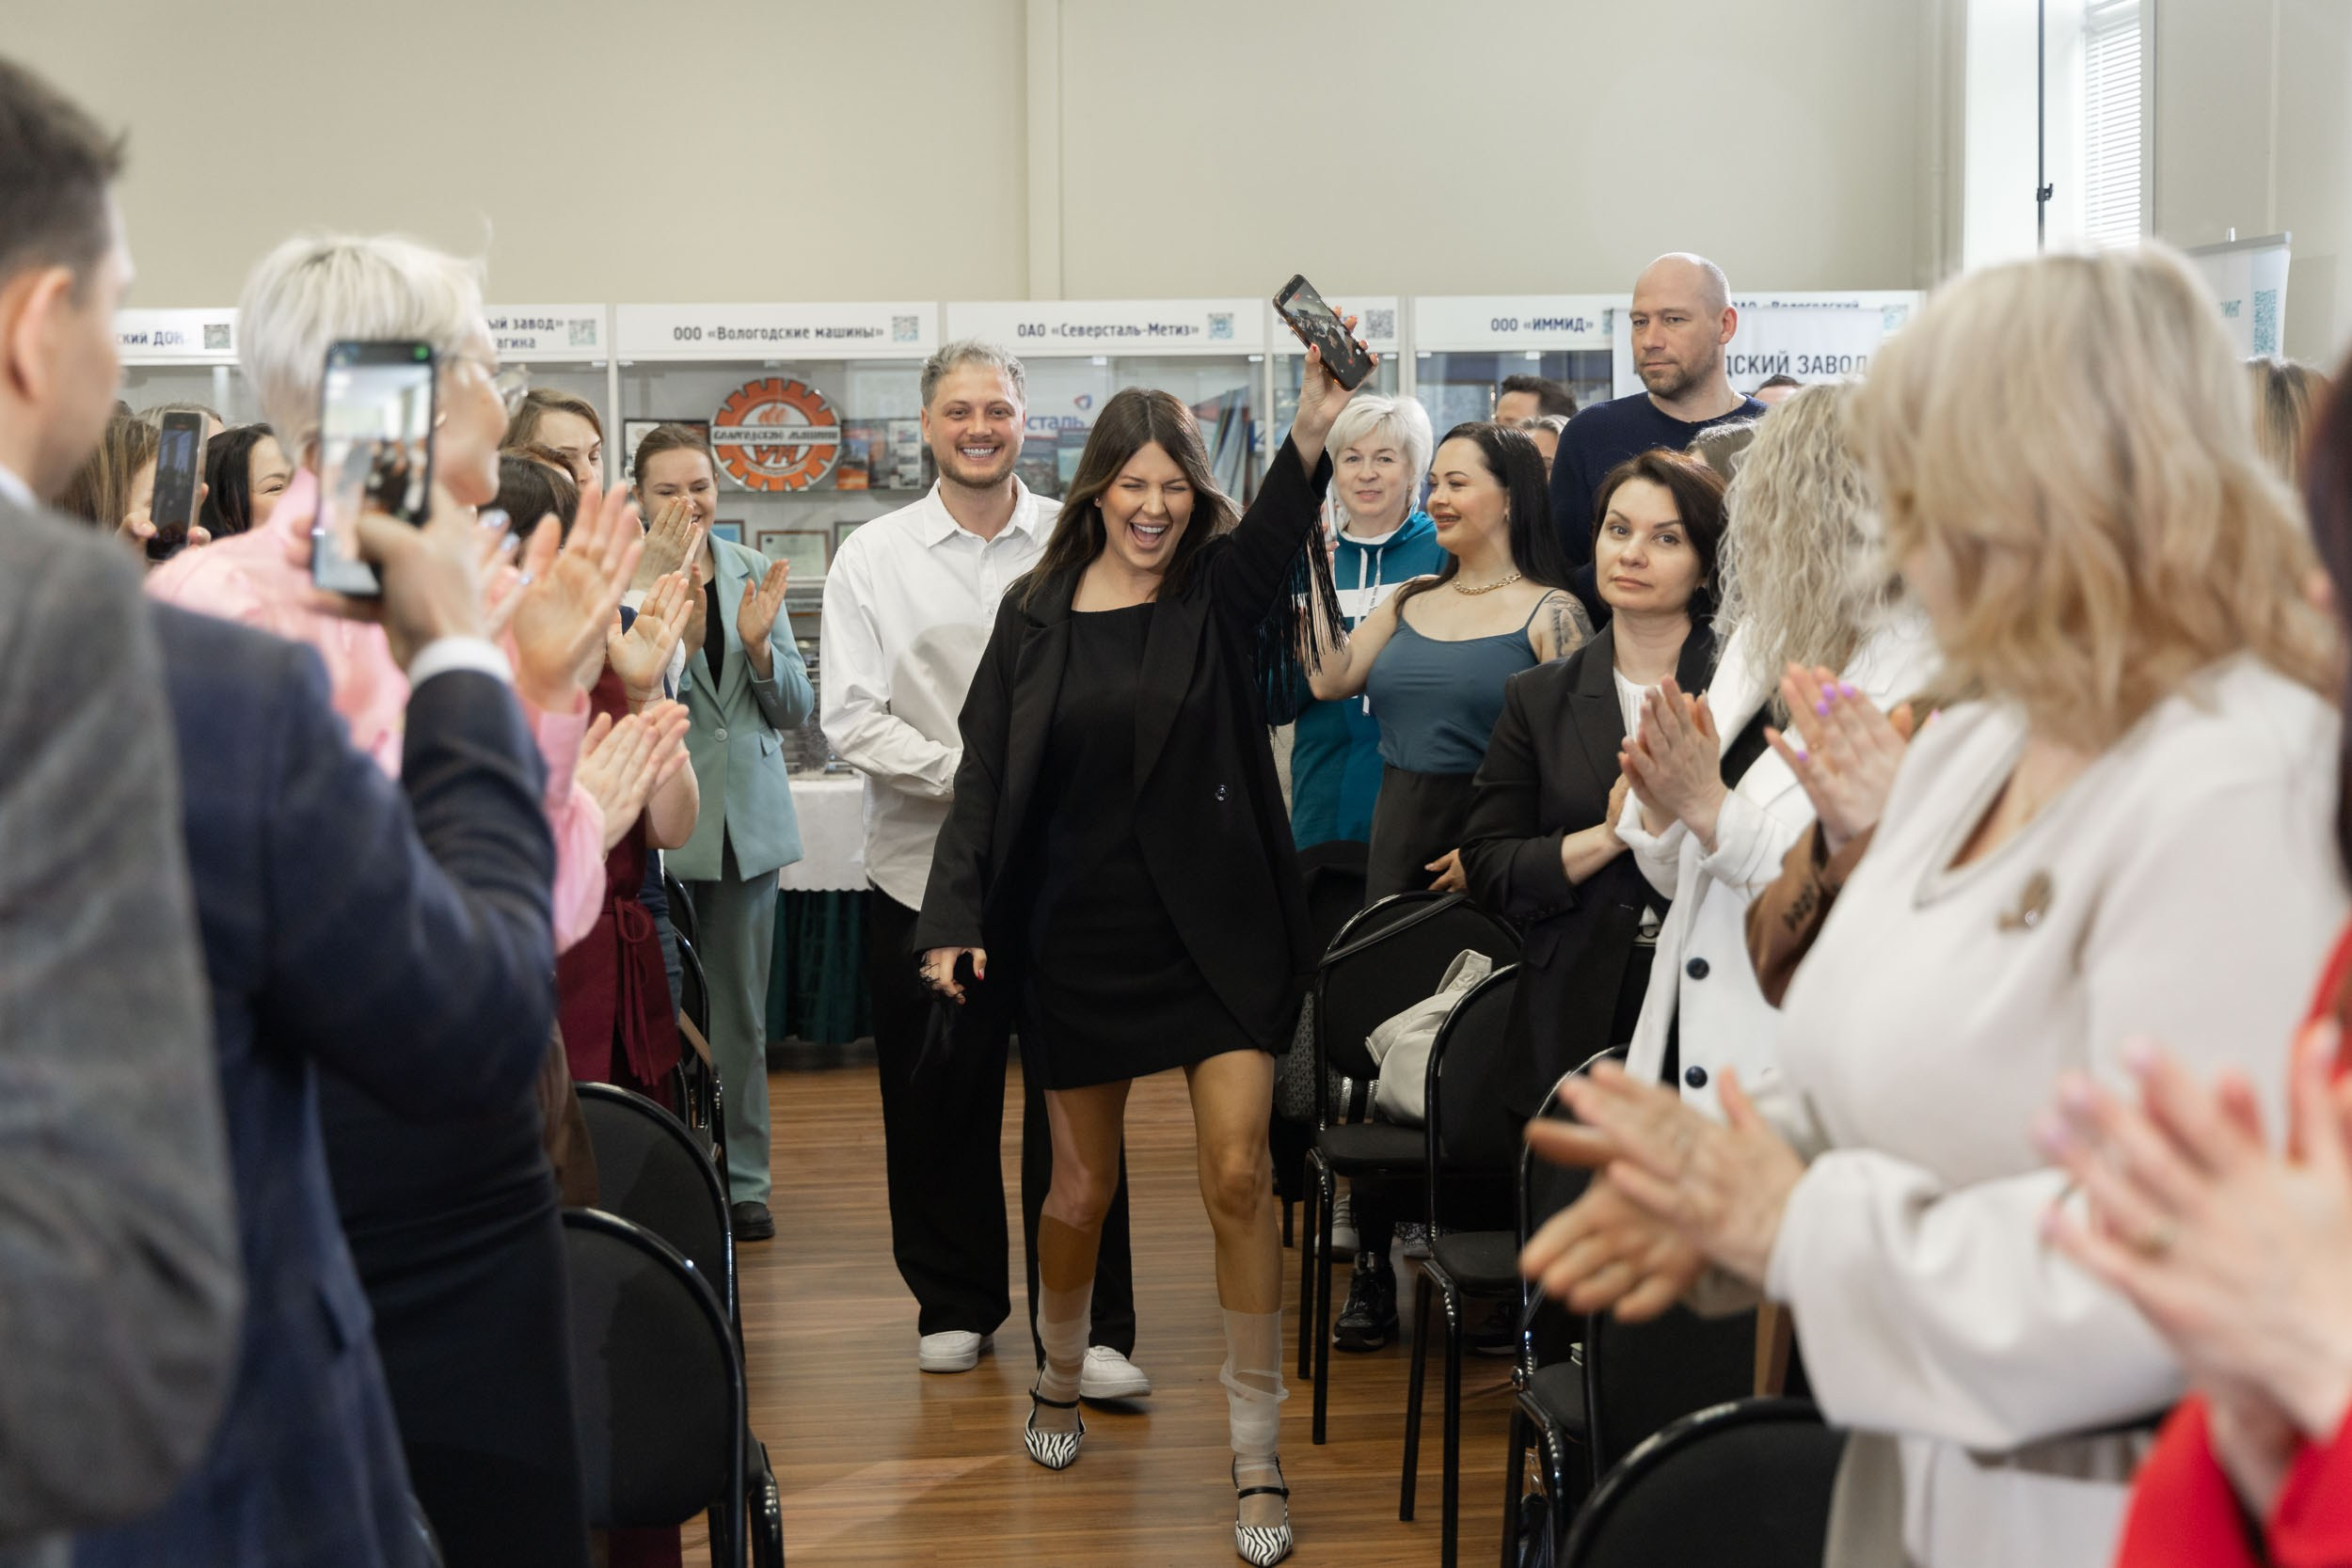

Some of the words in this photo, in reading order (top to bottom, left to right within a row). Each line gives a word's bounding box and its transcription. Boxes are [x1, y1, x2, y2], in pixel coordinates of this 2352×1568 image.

[1017, 323, 1046, 338] ОАО
[1051, 323, 1200, 339] «Северсталь-Метиз»
[1490, 318, 1518, 332] ООО
[1522, 317, 1595, 332] «ИММИД»
[674, 326, 703, 341] ООО
[707, 325, 810, 341] «Вологодские
[815, 325, 884, 340] машины»
[1025, 415, 1085, 430] сталь
